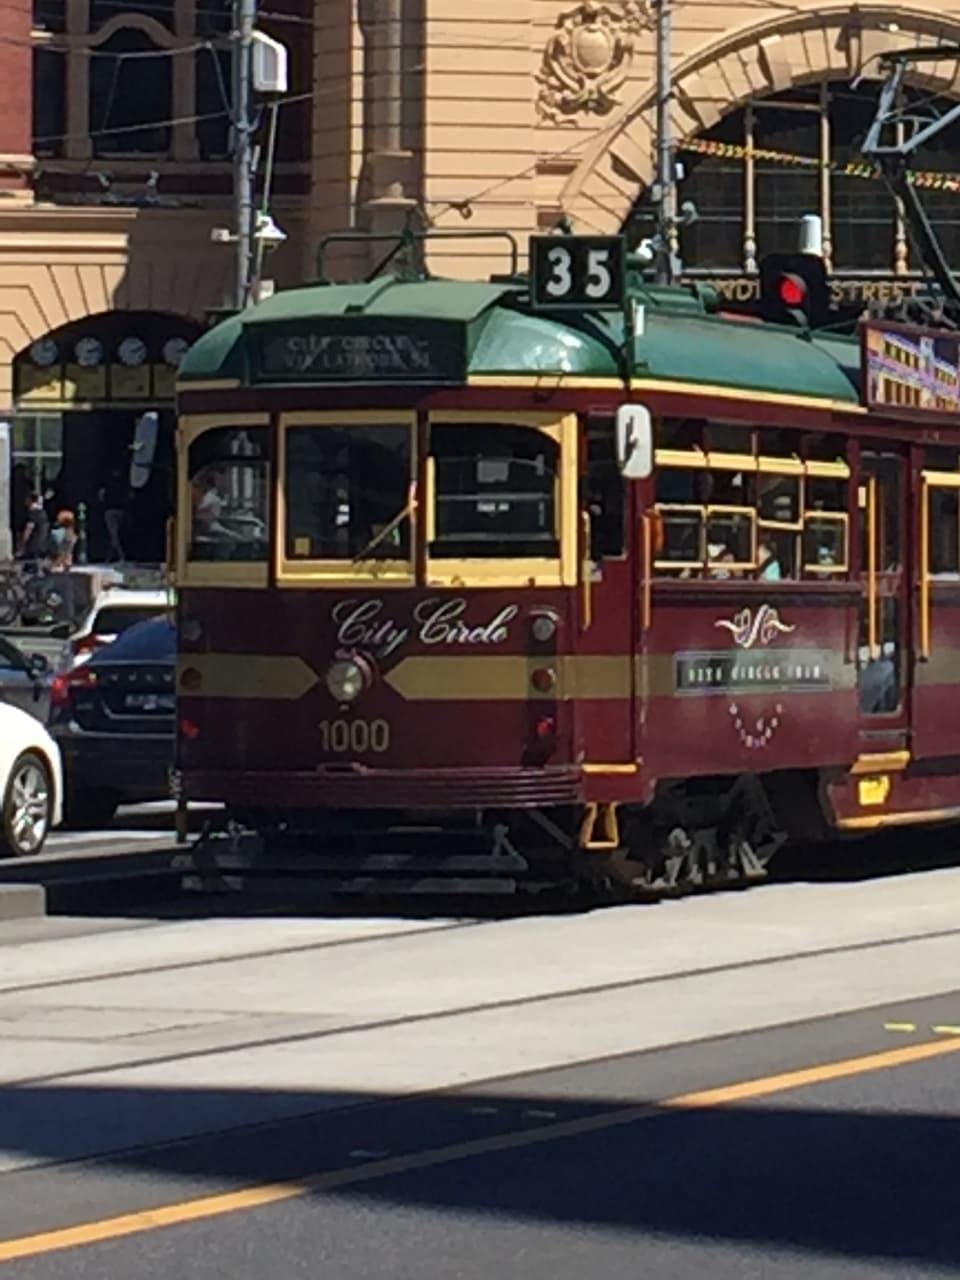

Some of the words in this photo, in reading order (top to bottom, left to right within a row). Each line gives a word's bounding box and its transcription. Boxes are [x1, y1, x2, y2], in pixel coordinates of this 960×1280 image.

[546, 246, 611, 298] 35
[332, 599, 409, 658] City
[413, 598, 519, 645] Circle
[318, 719, 391, 753] 1000
